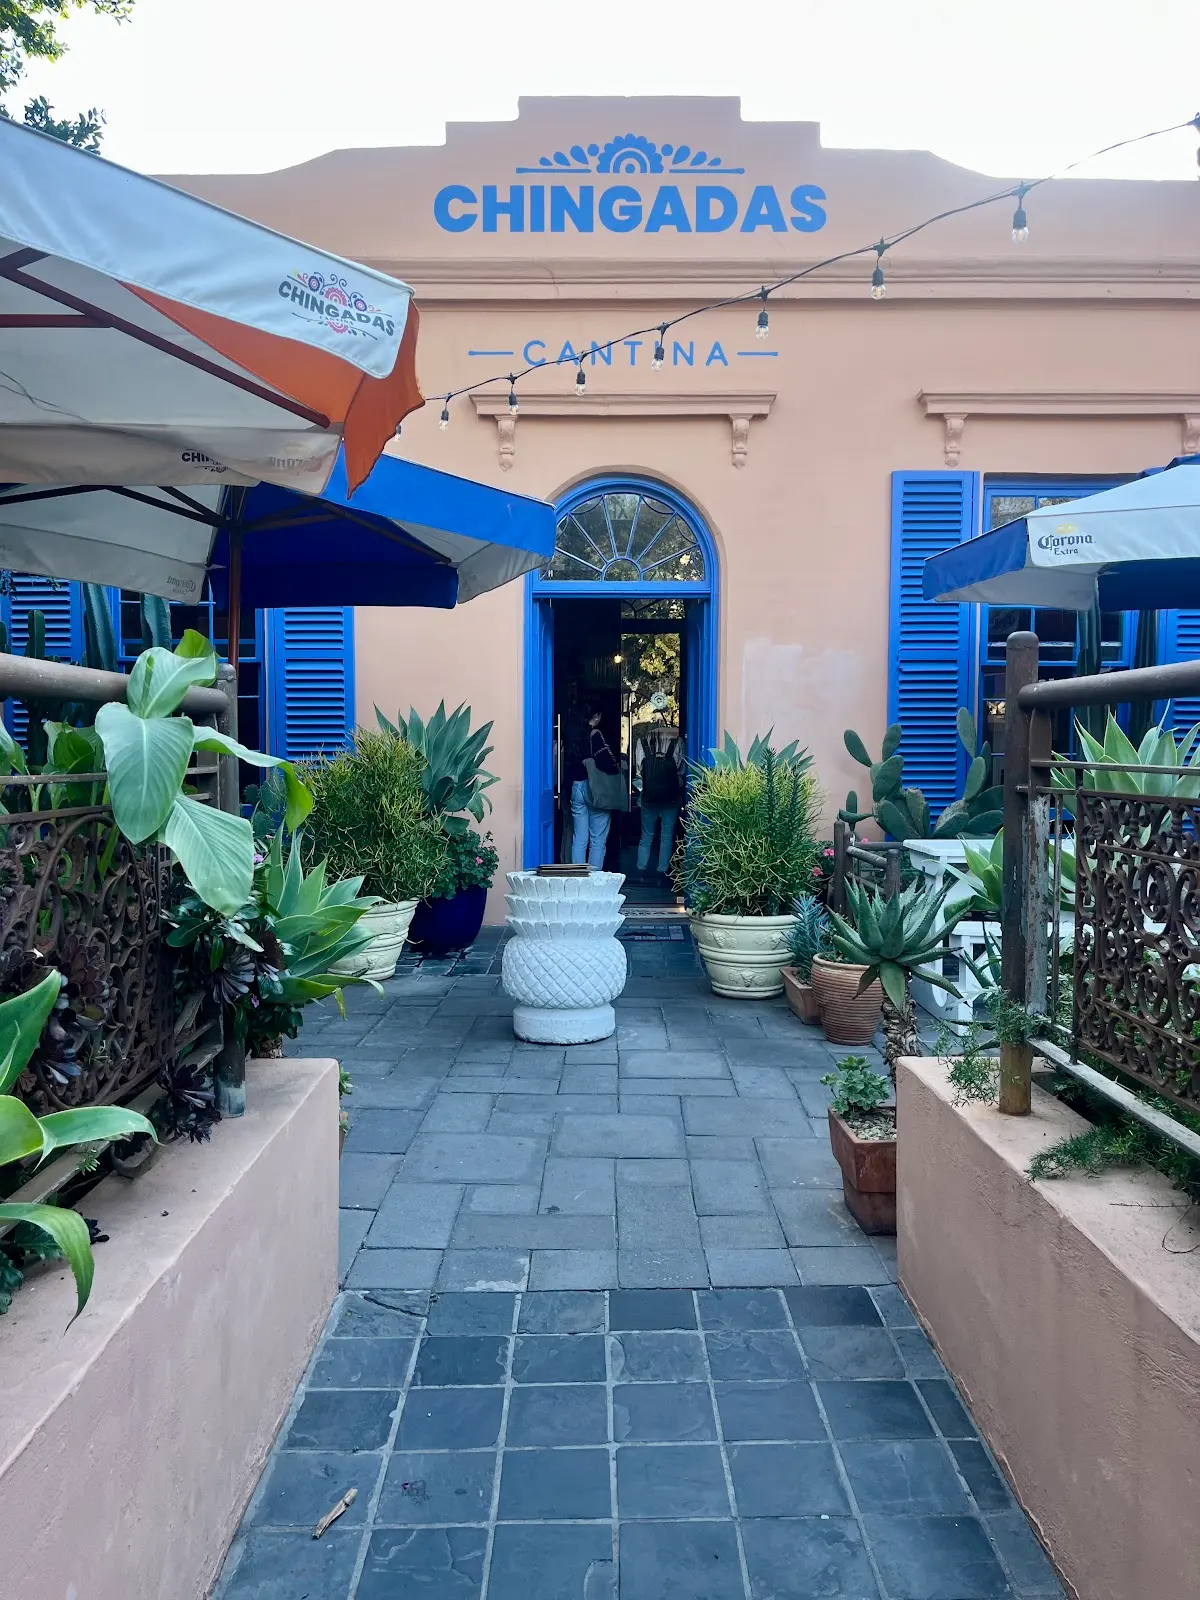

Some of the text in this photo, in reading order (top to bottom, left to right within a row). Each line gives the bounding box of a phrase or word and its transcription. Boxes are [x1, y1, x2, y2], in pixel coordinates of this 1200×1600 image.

[433, 184, 827, 233] CHINGADAS
[278, 280, 395, 336] CHINGADAS
[1037, 534, 1093, 551] Corona
[1053, 548, 1079, 556] Extra
